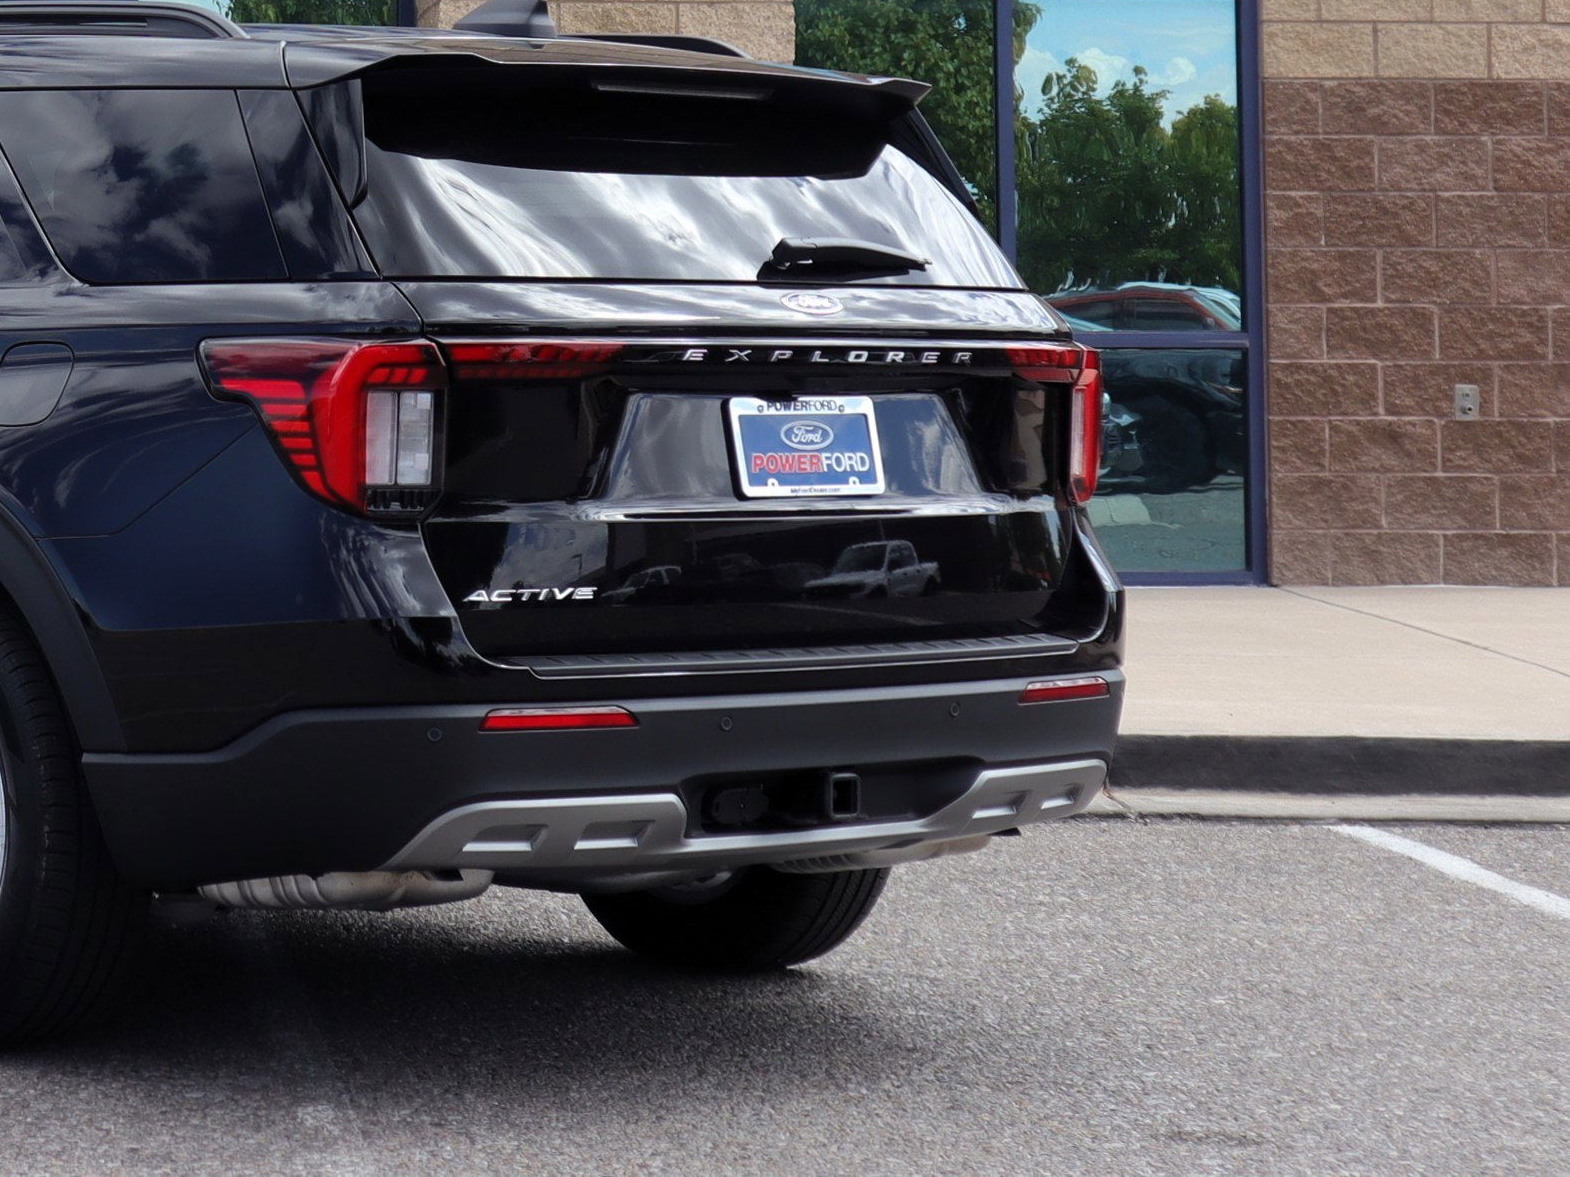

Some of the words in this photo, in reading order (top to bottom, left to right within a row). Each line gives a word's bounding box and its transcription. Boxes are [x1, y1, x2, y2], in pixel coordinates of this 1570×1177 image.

[682, 348, 973, 364] EXPLORER
[766, 399, 838, 412] POWERFORD
[791, 425, 823, 443] Ford
[751, 452, 870, 473] POWERFORD
[462, 586, 598, 602] ACTIVE
